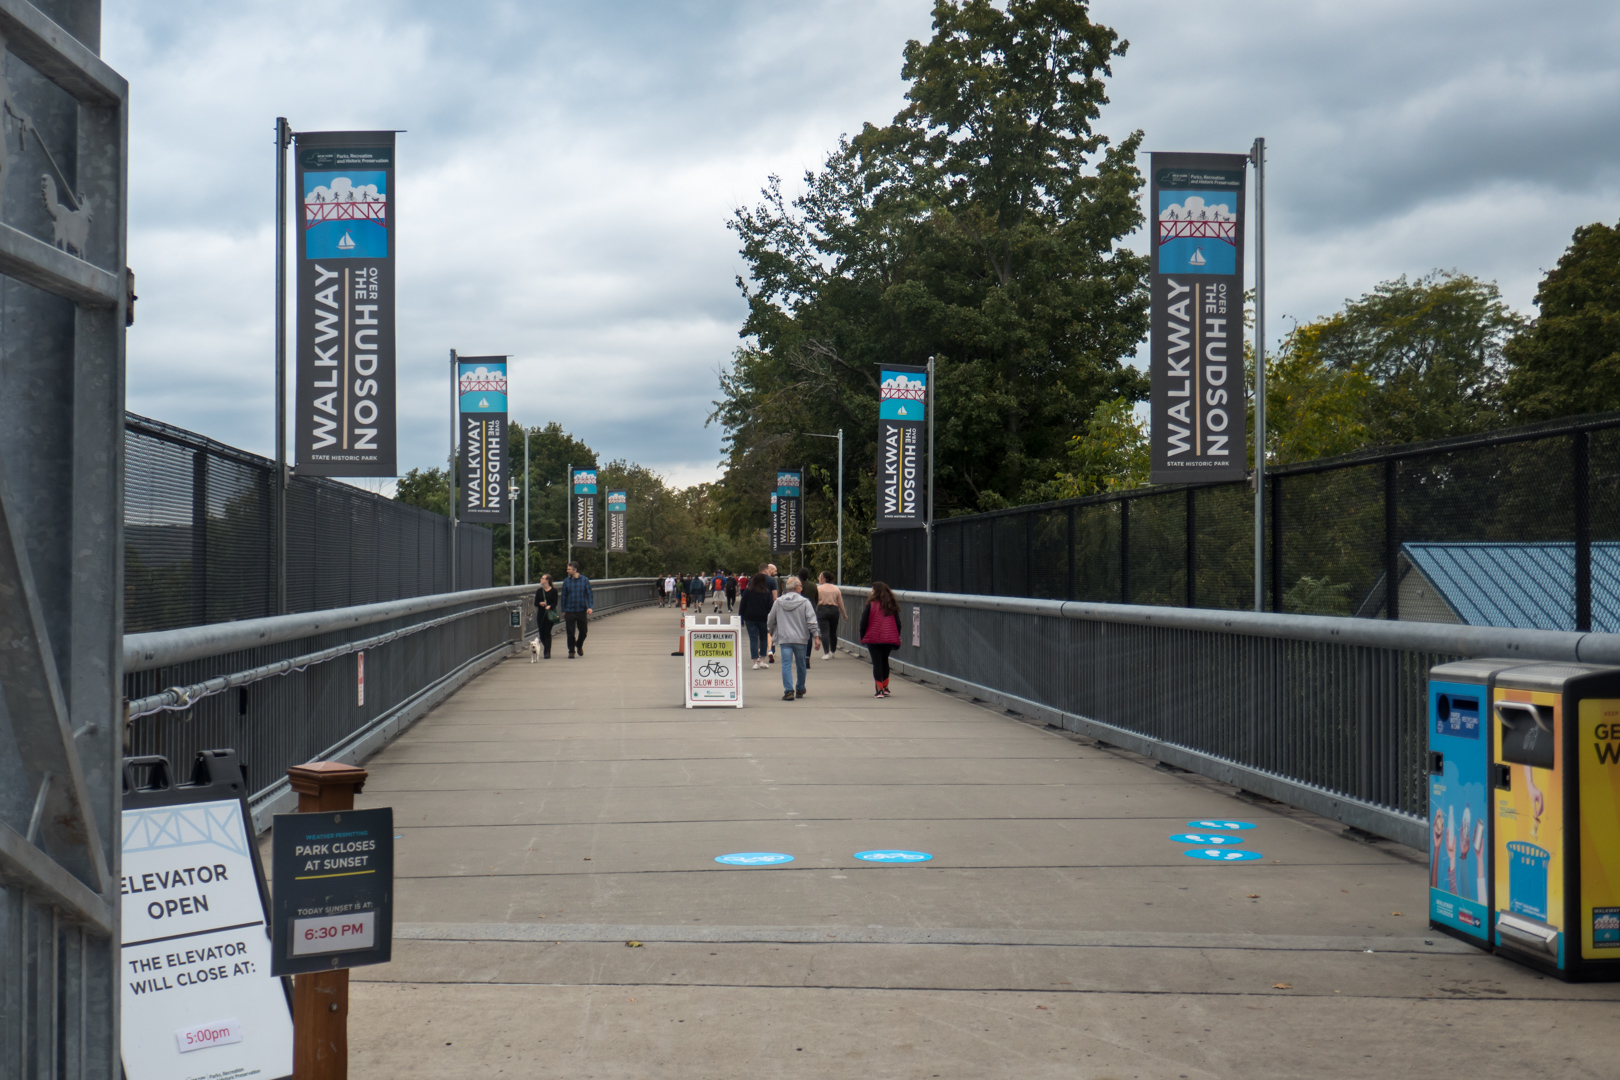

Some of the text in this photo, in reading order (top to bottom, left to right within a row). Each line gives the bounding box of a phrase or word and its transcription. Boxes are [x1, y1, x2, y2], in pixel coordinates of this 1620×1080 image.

[355, 268, 367, 300] THE
[369, 268, 378, 300] OVER
[1206, 283, 1216, 314] THE
[1218, 283, 1226, 314] OVER
[312, 264, 338, 450] WALKWAY
[1167, 278, 1190, 457] WALKWAY
[354, 304, 378, 449] HUDSON
[1206, 318, 1229, 456] HUDSON
[468, 418, 480, 508] WALKWAY
[488, 438, 500, 508] HUDSON
[884, 424, 898, 514] WALKWAY
[904, 445, 916, 513] HUDSON
[295, 840, 375, 856] PARK CLOSES
[304, 856, 368, 871] AT SUNSET
[121, 864, 228, 895] ELEVATOR
[148, 894, 209, 919] OPEN
[297, 907, 323, 916] TODAY
[325, 904, 353, 913] SUNSET
[304, 923, 363, 940] 6:30 PM
[129, 942, 247, 974] THE ELEVATOR
[130, 961, 256, 995] WILL CLOSE AT:
[186, 1028, 230, 1044] 5:00pm
[234, 1069, 261, 1078] Preservation
